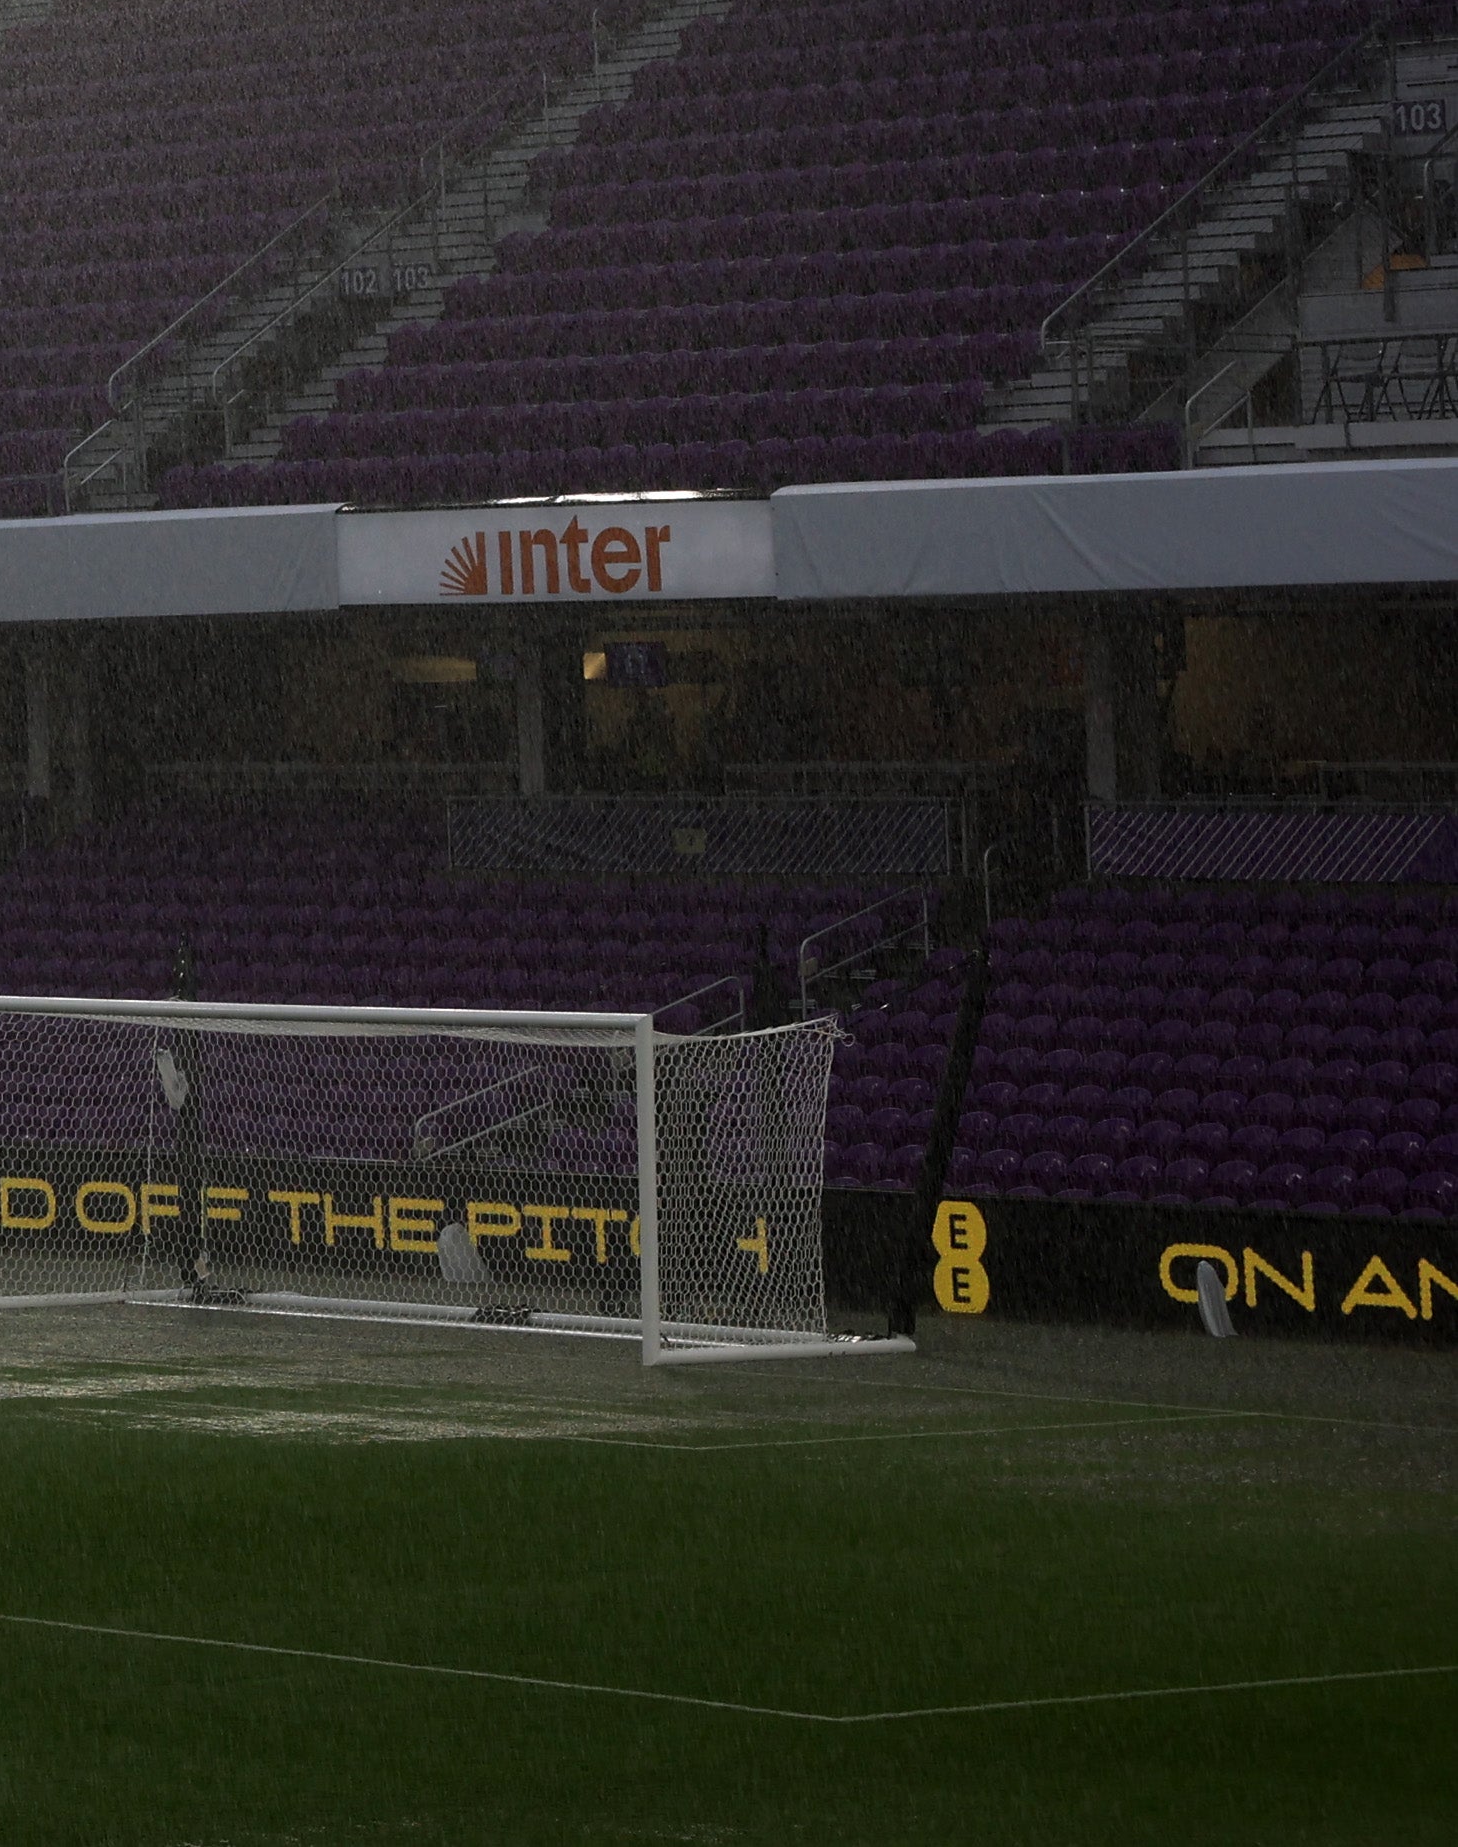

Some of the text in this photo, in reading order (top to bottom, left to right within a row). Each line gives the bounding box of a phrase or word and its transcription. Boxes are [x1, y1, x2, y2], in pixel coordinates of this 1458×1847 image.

[1396, 102, 1442, 131] 103
[341, 266, 429, 295] 102 103
[499, 514, 670, 595] inter
[75, 1181, 250, 1235] OFF
[268, 1190, 446, 1252] THE
[1159, 1243, 1316, 1312] ON
